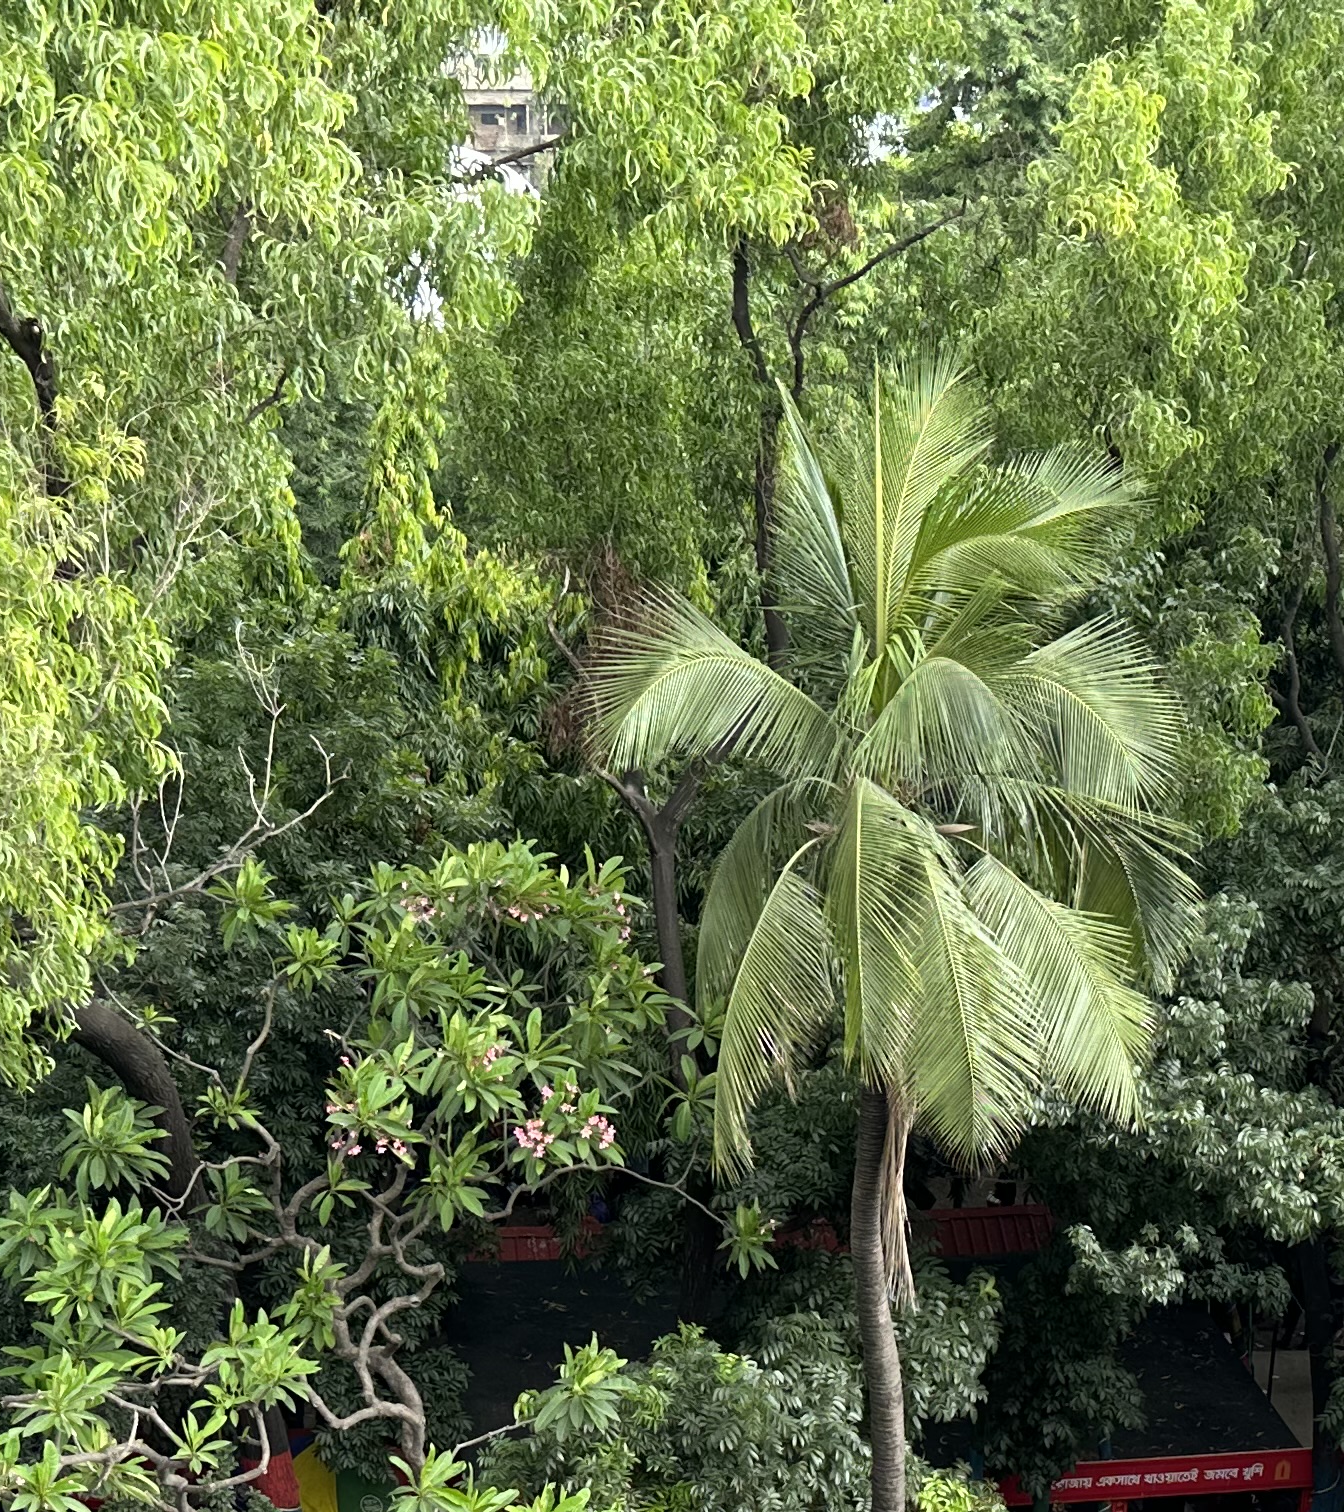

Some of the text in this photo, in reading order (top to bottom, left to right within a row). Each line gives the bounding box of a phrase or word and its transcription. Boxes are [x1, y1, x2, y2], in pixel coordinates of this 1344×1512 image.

[1096, 1474, 1141, 1488] একসাথে
[1144, 1468, 1199, 1484] খাওয়াতেই
[1203, 1467, 1239, 1480] জমবে
[1242, 1463, 1264, 1480] খুশি
